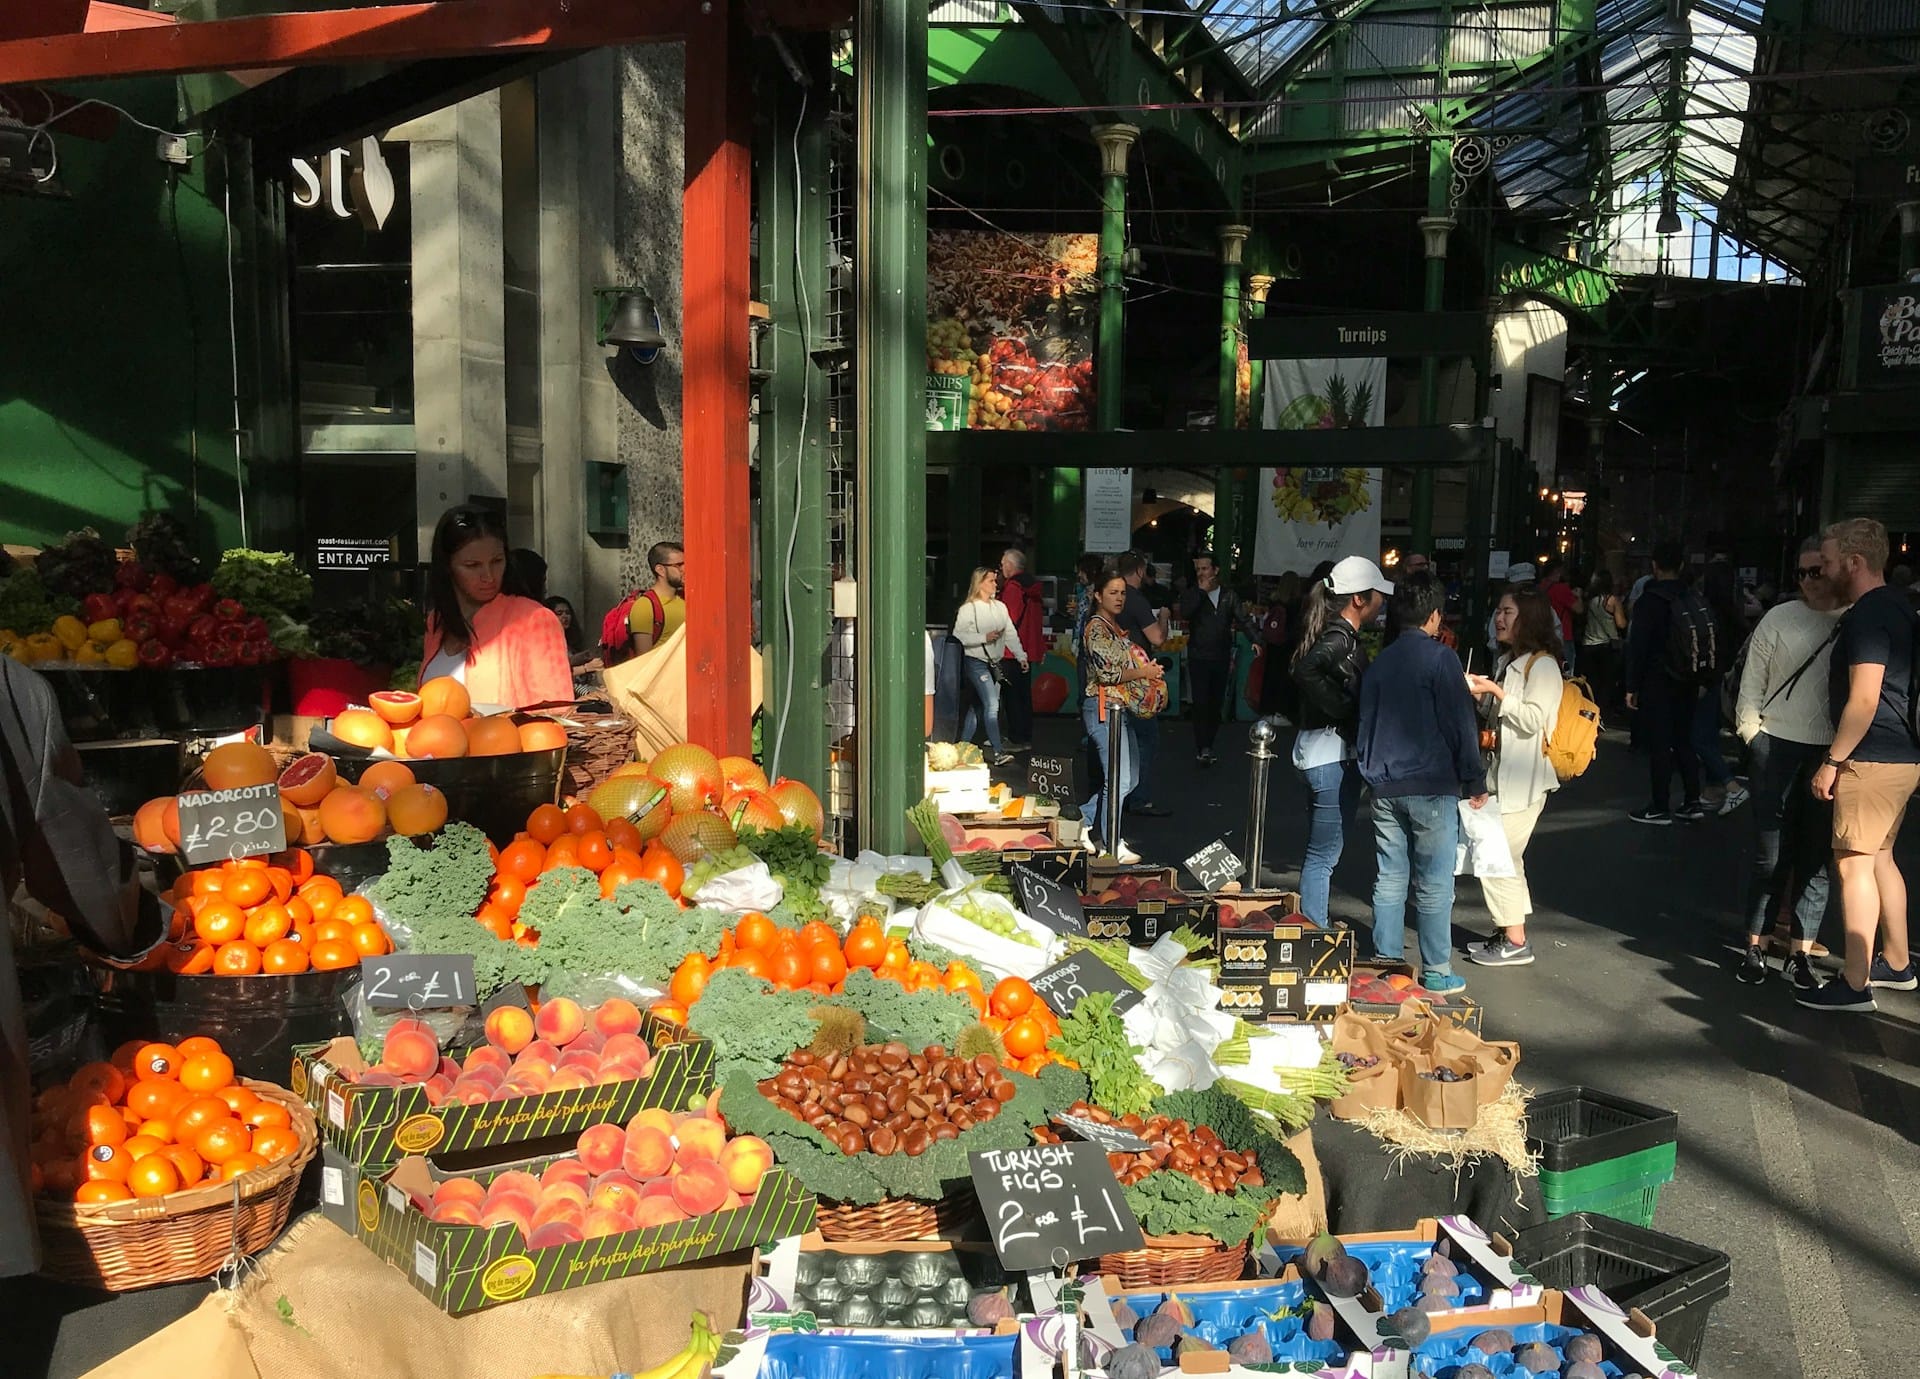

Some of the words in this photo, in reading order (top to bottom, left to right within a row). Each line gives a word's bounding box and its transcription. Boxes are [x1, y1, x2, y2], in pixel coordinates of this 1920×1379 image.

[1338, 326, 1387, 345] Turnips
[318, 552, 390, 564] ENTRANCE
[185, 807, 278, 853] £2.80
[1199, 870, 1217, 891] 2
[1022, 876, 1057, 916] £2
[367, 967, 399, 1000] 2
[422, 970, 464, 1002] £1
[493, 1111, 534, 1131] fruta
[536, 1105, 562, 1121] del
[980, 1144, 1075, 1172] TURKISH
[999, 1200, 1040, 1253] 2
[1035, 1211, 1060, 1228] FOR
[1070, 1188, 1124, 1245] £1
[568, 1258, 588, 1274] la
[588, 1249, 632, 1271] fruta
[632, 1244, 659, 1260] del
